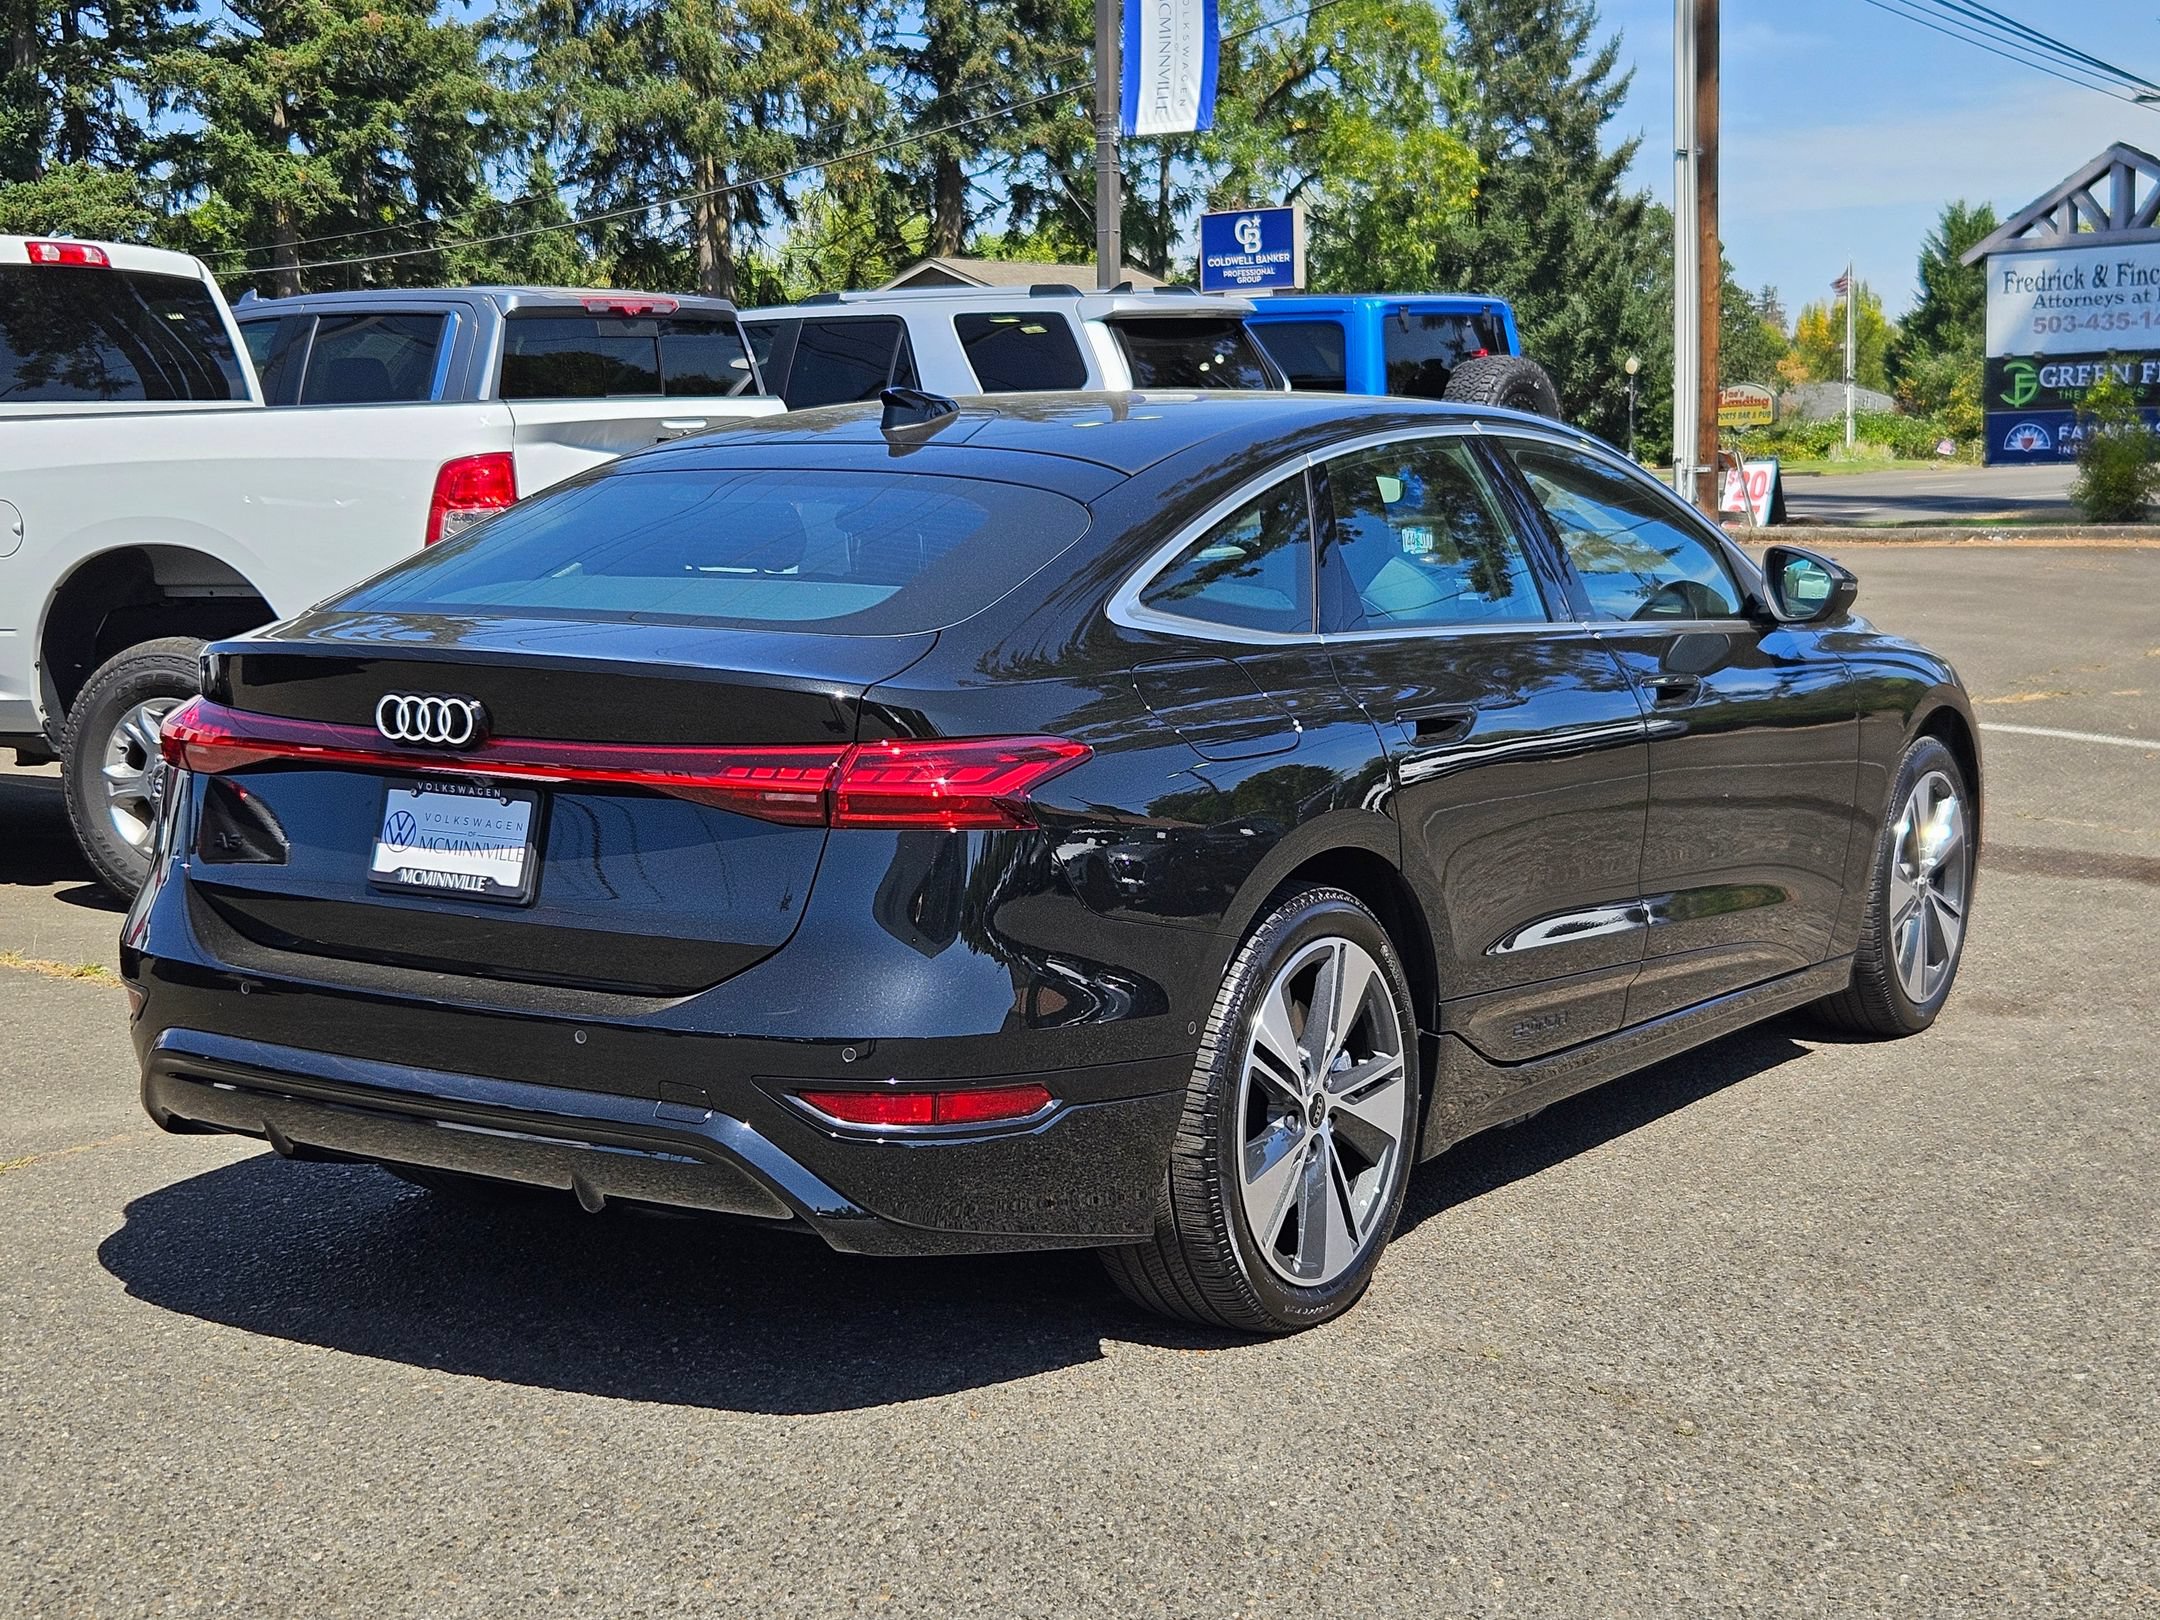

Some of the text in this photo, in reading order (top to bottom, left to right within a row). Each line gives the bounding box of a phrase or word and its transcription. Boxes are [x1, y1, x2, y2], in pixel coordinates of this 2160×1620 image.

[1154, 0, 1172, 116] CMINNVILLE
[1207, 253, 1290, 268] COLDWELL BANKER
[1223, 267, 1275, 279] PROFESSIONAL
[1237, 275, 1261, 284] GROUP
[2004, 271, 2084, 294] Fredrick
[2092, 265, 2109, 288] &
[2032, 291, 2125, 310] Attorneys
[2132, 290, 2151, 304] at
[2039, 359, 2160, 388] GREEN F
[2057, 389, 2080, 400] THE
[1738, 411, 1750, 420] BAR
[1759, 410, 1771, 419] PUB
[417, 782, 501, 797] VOLKSWAGEN
[424, 813, 524, 831] VOLKSWAGEN
[419, 835, 524, 863] MCMINNVILLE
[399, 868, 487, 892] MCMINNVILLE
